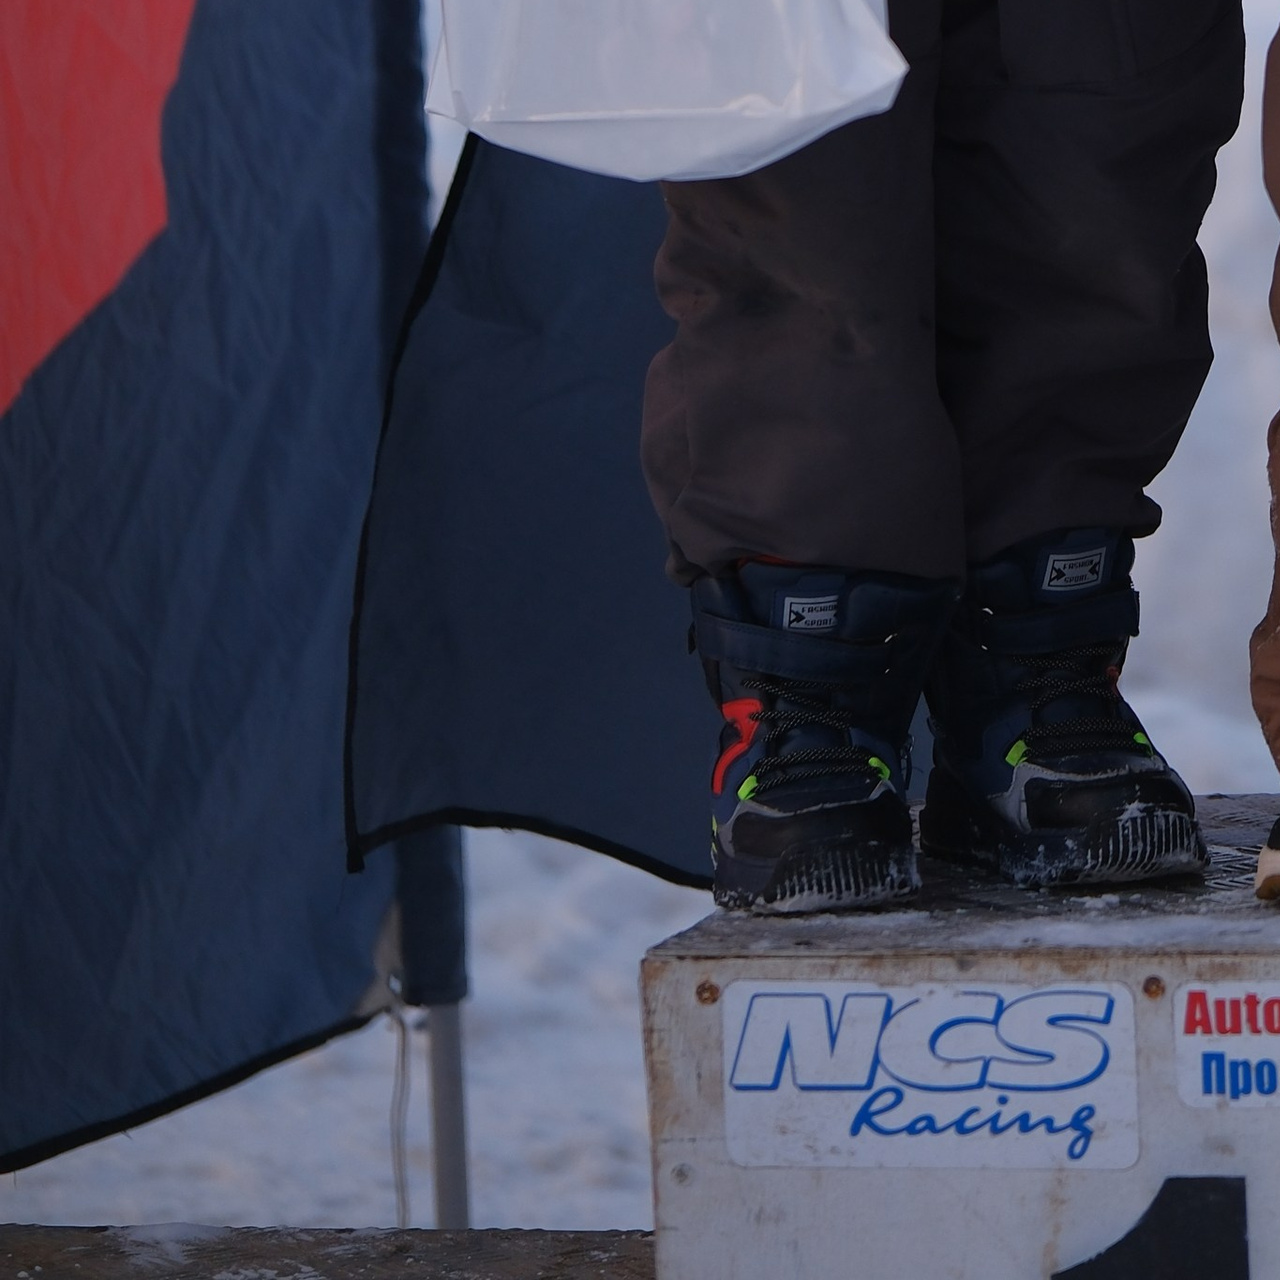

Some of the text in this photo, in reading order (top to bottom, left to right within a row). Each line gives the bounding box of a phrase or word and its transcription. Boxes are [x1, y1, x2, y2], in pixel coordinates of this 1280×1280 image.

[729, 990, 1116, 1091] NCS
[1201, 1051, 1278, 1100] Про
[849, 1086, 1097, 1160] Racing
